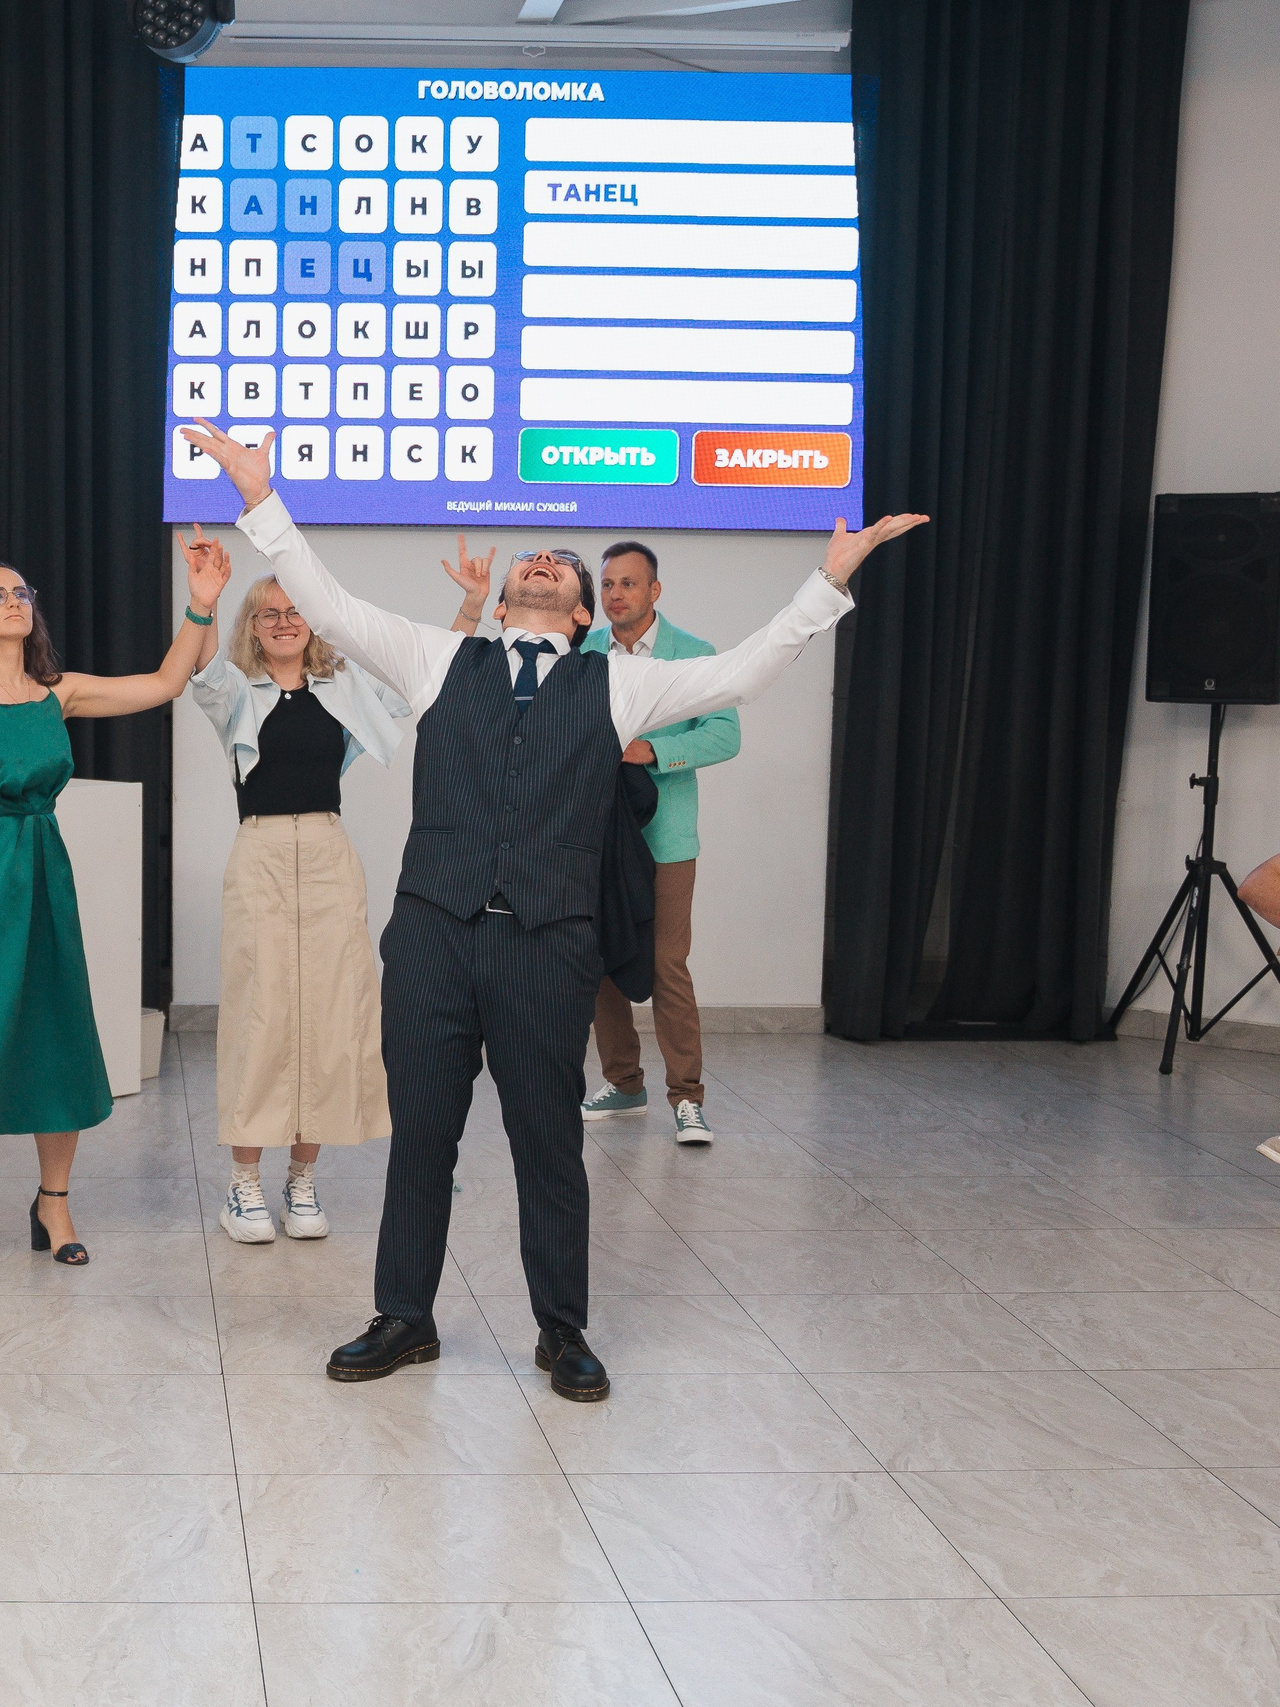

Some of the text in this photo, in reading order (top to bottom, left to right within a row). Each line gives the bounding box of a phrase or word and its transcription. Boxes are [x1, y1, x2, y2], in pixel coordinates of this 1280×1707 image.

[418, 80, 605, 102] ГОЛОВОЛОМКА
[189, 132, 483, 155] А Т С О К У
[190, 194, 482, 216] К А Н Л Н В
[546, 182, 639, 207] ТАНЕЦ
[190, 257, 484, 283] Н П Е Ц Ы Ы
[188, 319, 479, 340] А Л О К Ш Р
[189, 381, 479, 403] К В Т П Е О
[189, 443, 477, 464] Р Я Н С К
[540, 445, 657, 467] ОТКРЫТЬ
[713, 447, 830, 470] ЗАКРЫТЬ
[446, 500, 578, 513] ВЕДУЩИЙ МИХАИЛ СУХОВЕЙ
